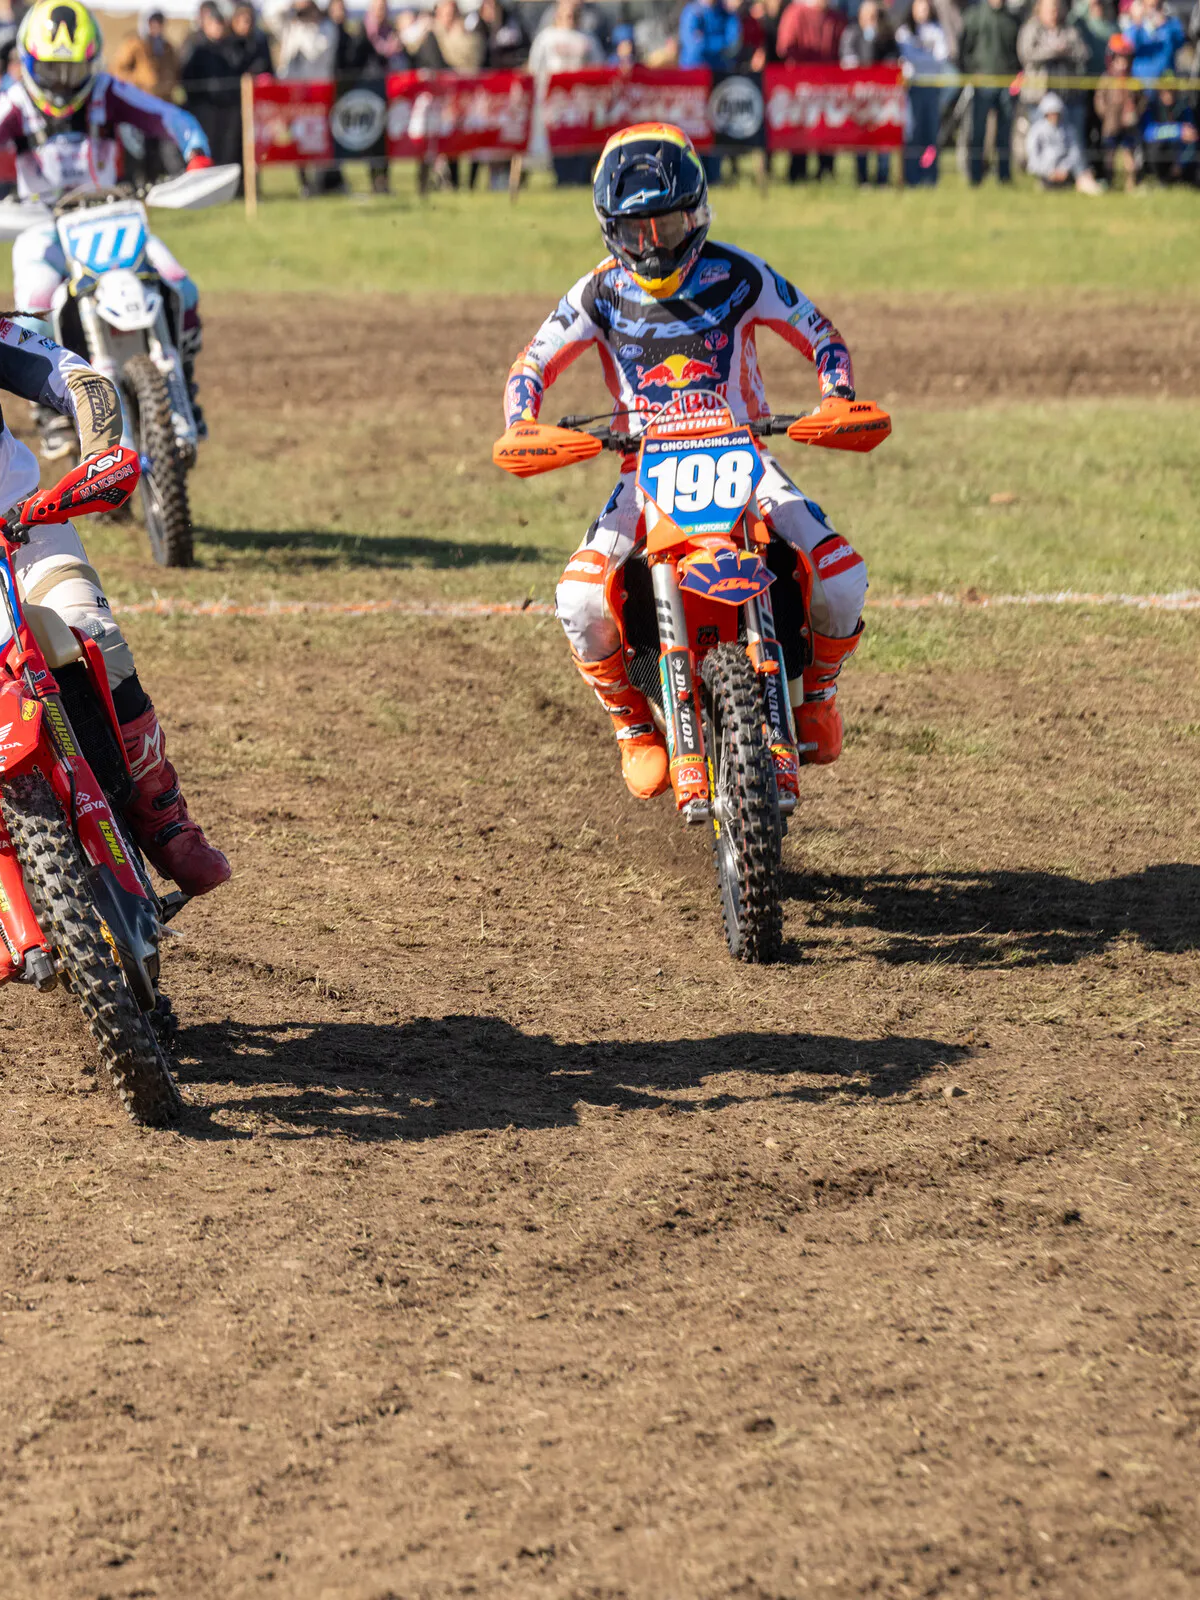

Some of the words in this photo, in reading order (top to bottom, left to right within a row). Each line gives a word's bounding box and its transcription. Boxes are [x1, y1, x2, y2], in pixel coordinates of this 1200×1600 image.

[69, 217, 141, 265] 777
[634, 390, 681, 421] Red
[685, 384, 728, 413] Bull
[657, 416, 727, 434] RENTHAL
[835, 421, 889, 434] ACERBIS
[499, 447, 557, 456] ACERBIS
[661, 436, 750, 451] GNCCRACING.COM
[87, 449, 123, 478] ASV
[80, 464, 134, 499] MAKSON
[647, 449, 754, 515] 198
[694, 521, 731, 533] MOTOREX
[708, 577, 761, 595] KTM
[766, 649, 781, 726] DUNLP
[675, 674, 695, 750] DLOP
[76, 800, 107, 819] UBYA
[98, 820, 127, 865] TAMER
